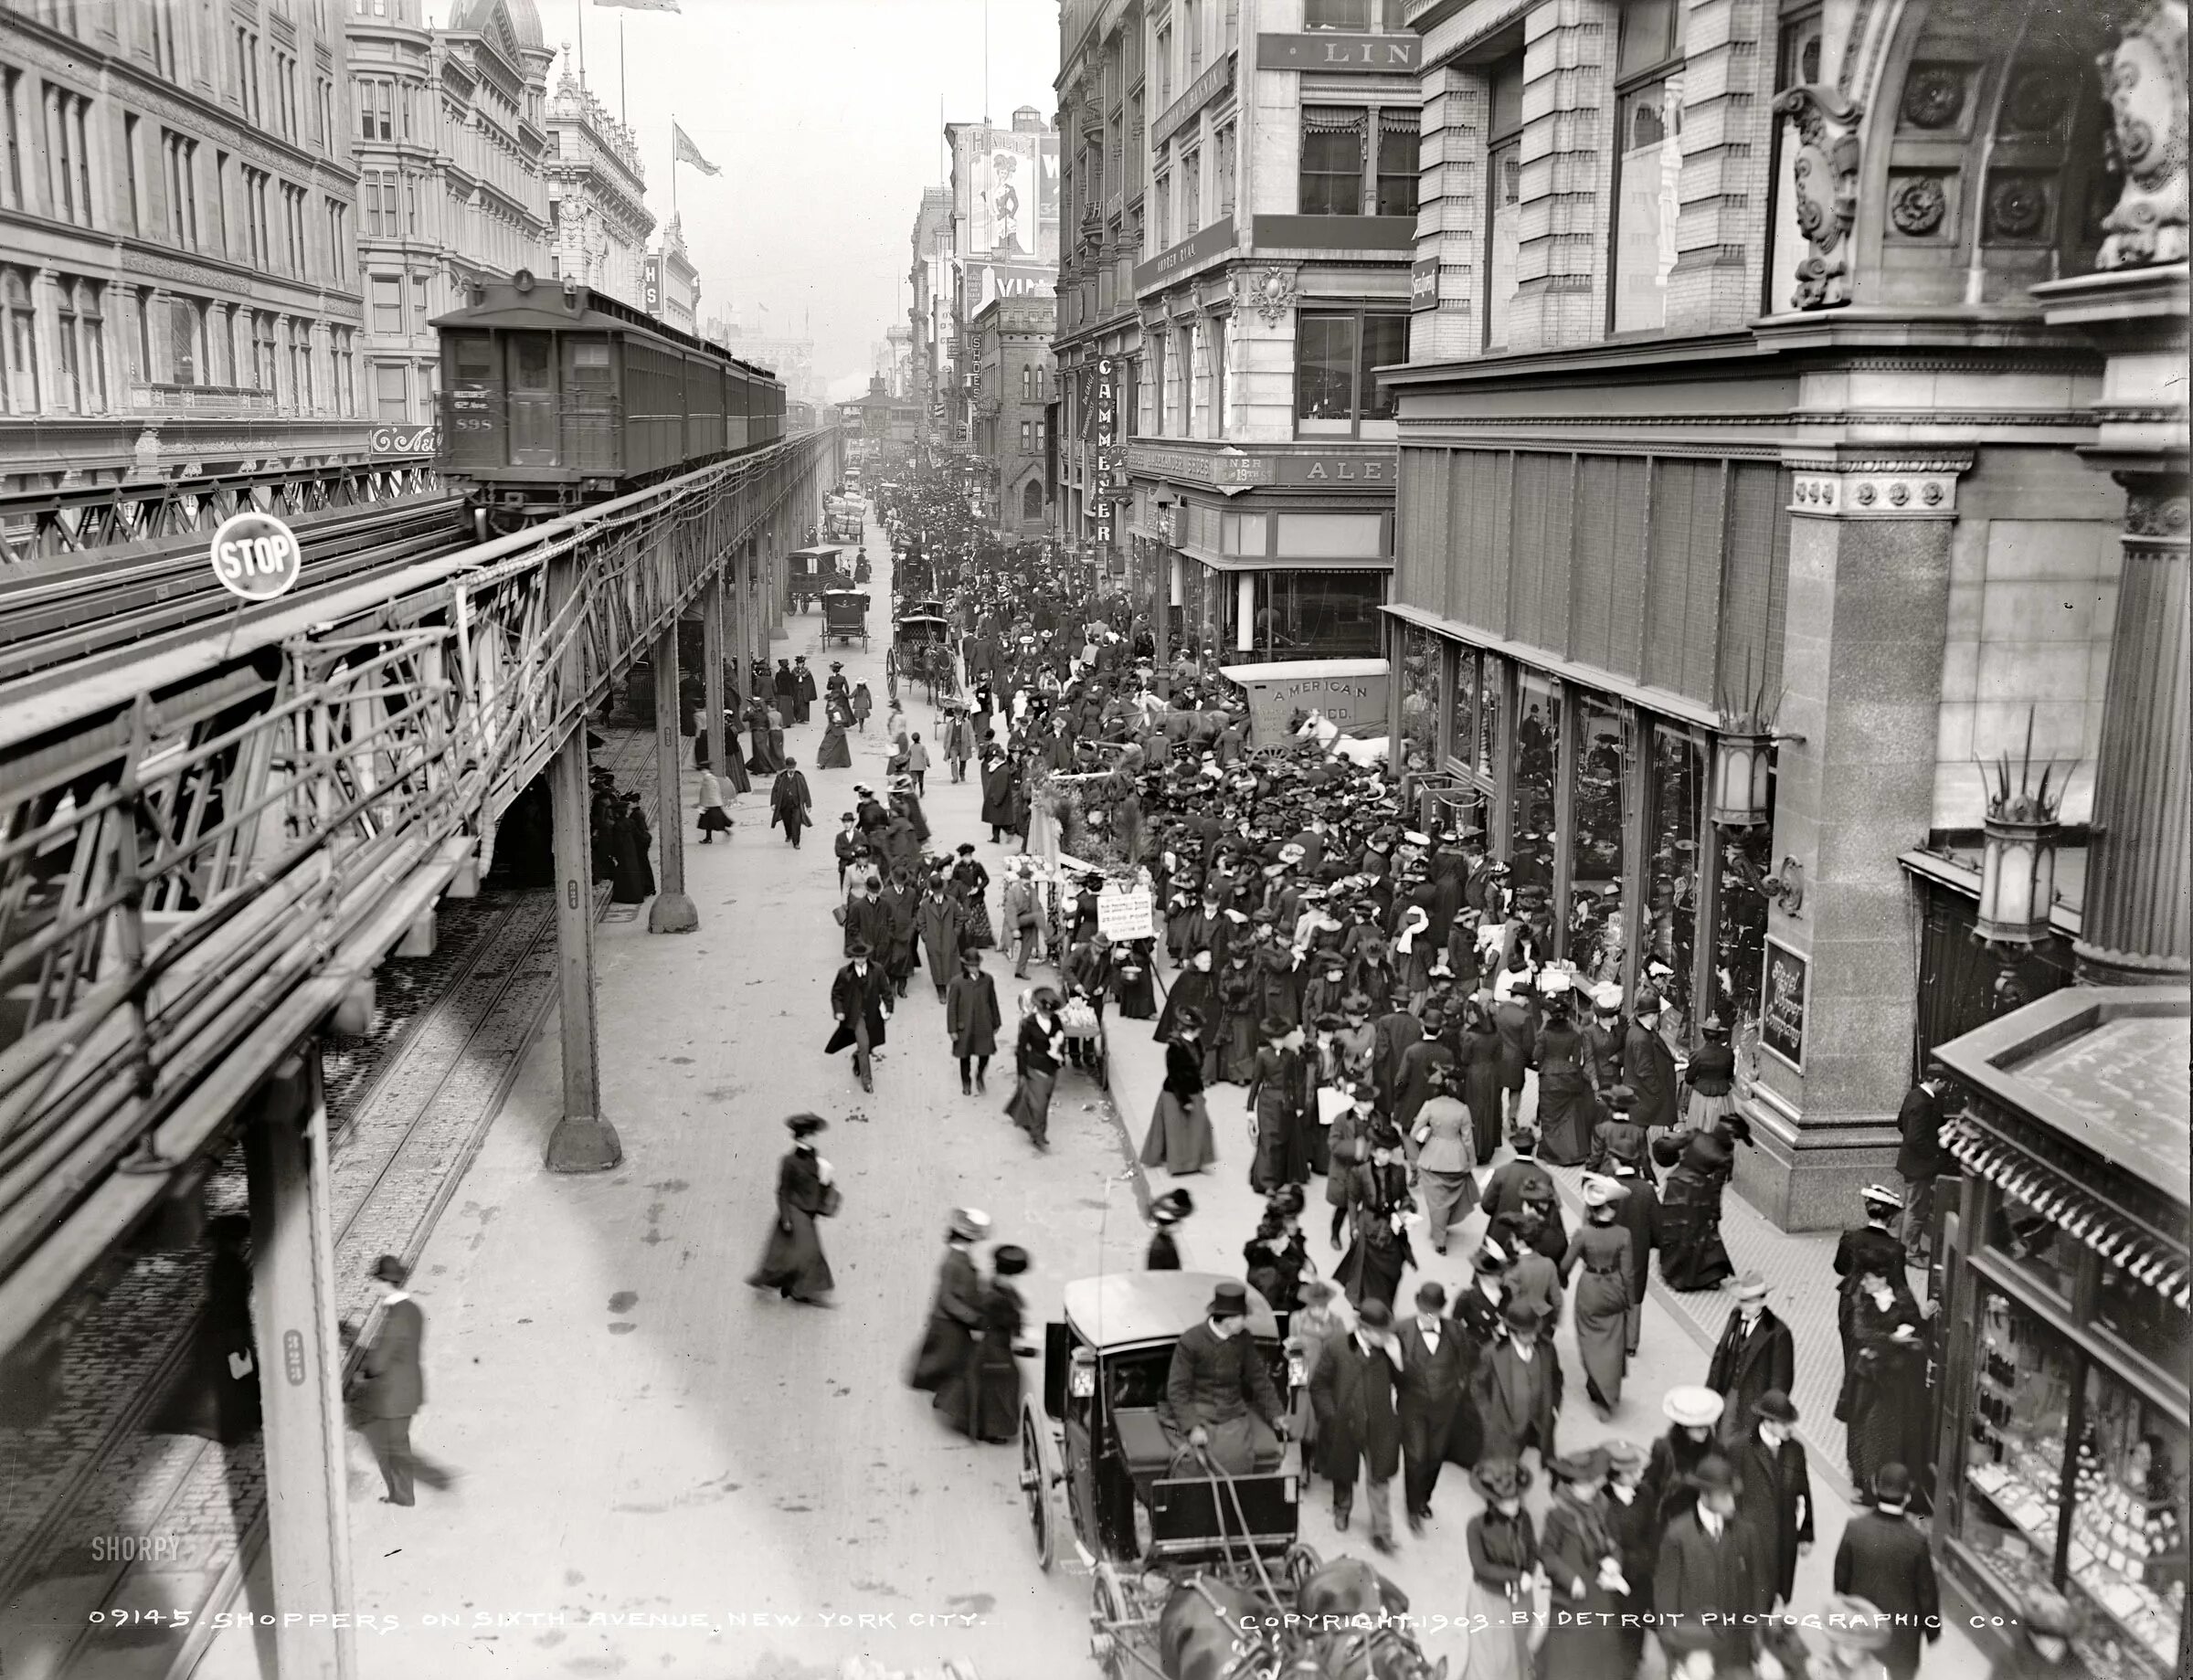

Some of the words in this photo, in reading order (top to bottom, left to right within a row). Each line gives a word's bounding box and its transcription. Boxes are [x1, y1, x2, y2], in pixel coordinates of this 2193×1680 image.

[219, 534, 291, 579] STOP
[1273, 681, 1367, 702] AMERICAN
[1327, 708, 1352, 720] CO.
